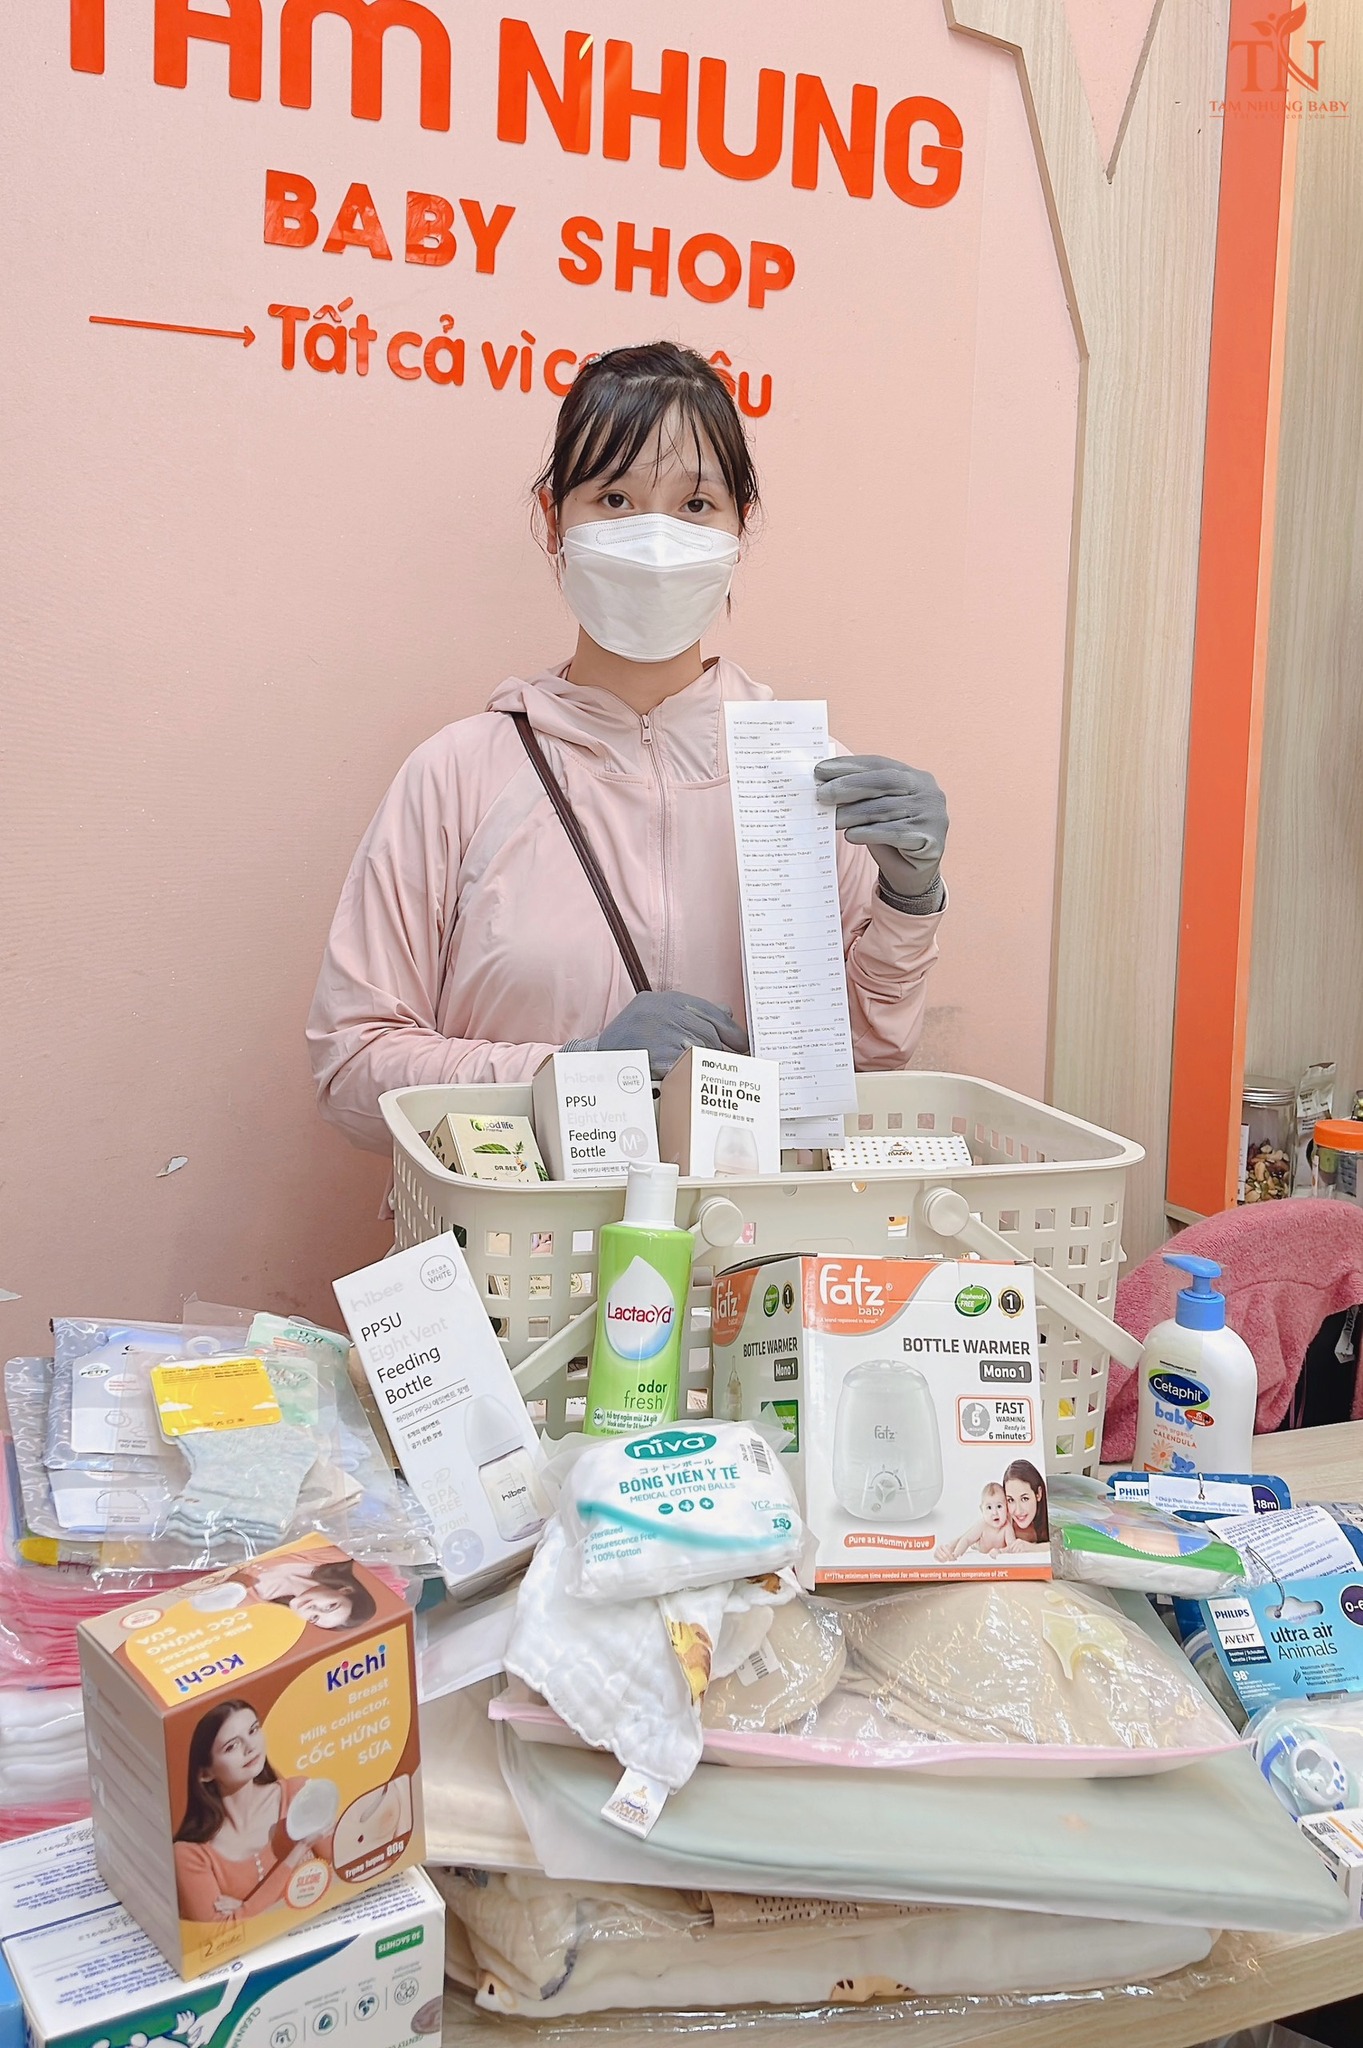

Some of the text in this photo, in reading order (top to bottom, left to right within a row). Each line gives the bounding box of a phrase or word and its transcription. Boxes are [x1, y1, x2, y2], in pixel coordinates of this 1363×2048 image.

[497, 18, 963, 208] NHUNG
[263, 169, 796, 309] BABY SHOP
[267, 296, 378, 377] Tất
[386, 314, 466, 388] cả
[480, 330, 533, 394] vì
[701, 1059, 738, 1073] moyuum
[622, 1079, 641, 1087] WHITE
[700, 1073, 761, 1092] Premium PPSU
[565, 1095, 597, 1108] PPSU
[700, 1083, 761, 1103] All in One
[700, 1094, 739, 1111] Bottle
[599, 1111, 627, 1124] Vent
[568, 1128, 617, 1142] Feeding
[570, 1145, 606, 1159] Bottle
[426, 1263, 448, 1276] COLOR
[427, 1269, 453, 1285] WHITE
[819, 1263, 885, 1307] fatz
[716, 1279, 739, 1321] fatz
[960, 1300, 975, 1308] FREE
[1005, 1294, 1015, 1309] 1
[858, 1306, 885, 1317] baby
[360, 1311, 403, 1342] PPSU
[368, 1317, 449, 1364] Eight Vent
[743, 1336, 798, 1358] BOTTLE WARMER
[902, 1337, 1031, 1355] BOTTLE WARMER
[376, 1346, 441, 1384] Feeding
[775, 1362, 796, 1377] Mono 1
[983, 1364, 1026, 1379] Mono 1
[384, 1374, 434, 1405] Bottle
[637, 1379, 668, 1394] odor
[1153, 1377, 1202, 1403] Cetaphil
[623, 1389, 664, 1410] fresh
[995, 1402, 1024, 1414] FAST
[414, 1402, 433, 1416] PPSU
[643, 1414, 650, 1422] 24
[971, 1410, 981, 1427] 6
[874, 1425, 896, 1440] fatz
[988, 1432, 994, 1440] 6
[1153, 1428, 1198, 1449] CALENDULA
[1156, 1423, 1194, 1440] with organic
[632, 1436, 706, 1459] niva
[618, 1461, 741, 1495] BÔNG VIÊN Y TẾ
[428, 1484, 460, 1507] BPA
[501, 1485, 527, 1501] hibee
[629, 1480, 736, 1503] MEDICAL COTTON BALLS
[432, 1501, 464, 1519] FREE
[771, 1517, 792, 1531] ISO
[589, 1525, 624, 1542] Sterilized
[848, 1536, 866, 1544] Pure
[876, 1536, 913, 1549] Mommy's
[913, 1539, 930, 1549] love
[592, 1546, 643, 1564] 100% Cotton
[1214, 1608, 1250, 1620] PHILIPS
[1224, 1633, 1256, 1645] AVENT
[1270, 1621, 1334, 1644] ultra air
[1278, 1639, 1339, 1661] Animals
[161, 1651, 211, 1676] Breast
[326, 1644, 386, 1692] Kichi
[174, 1653, 245, 1693] Kichi
[347, 1677, 390, 1705] Breast
[299, 1696, 391, 1745] Milk collector.
[296, 1715, 392, 1770] CỐC HỨNG
[357, 1738, 392, 1766] SỮA
[344, 1863, 365, 1880] Trọng
[386, 1840, 405, 1857] 80g
[204, 1940, 213, 1958] 2
[377, 1935, 412, 1954] SACHETS
